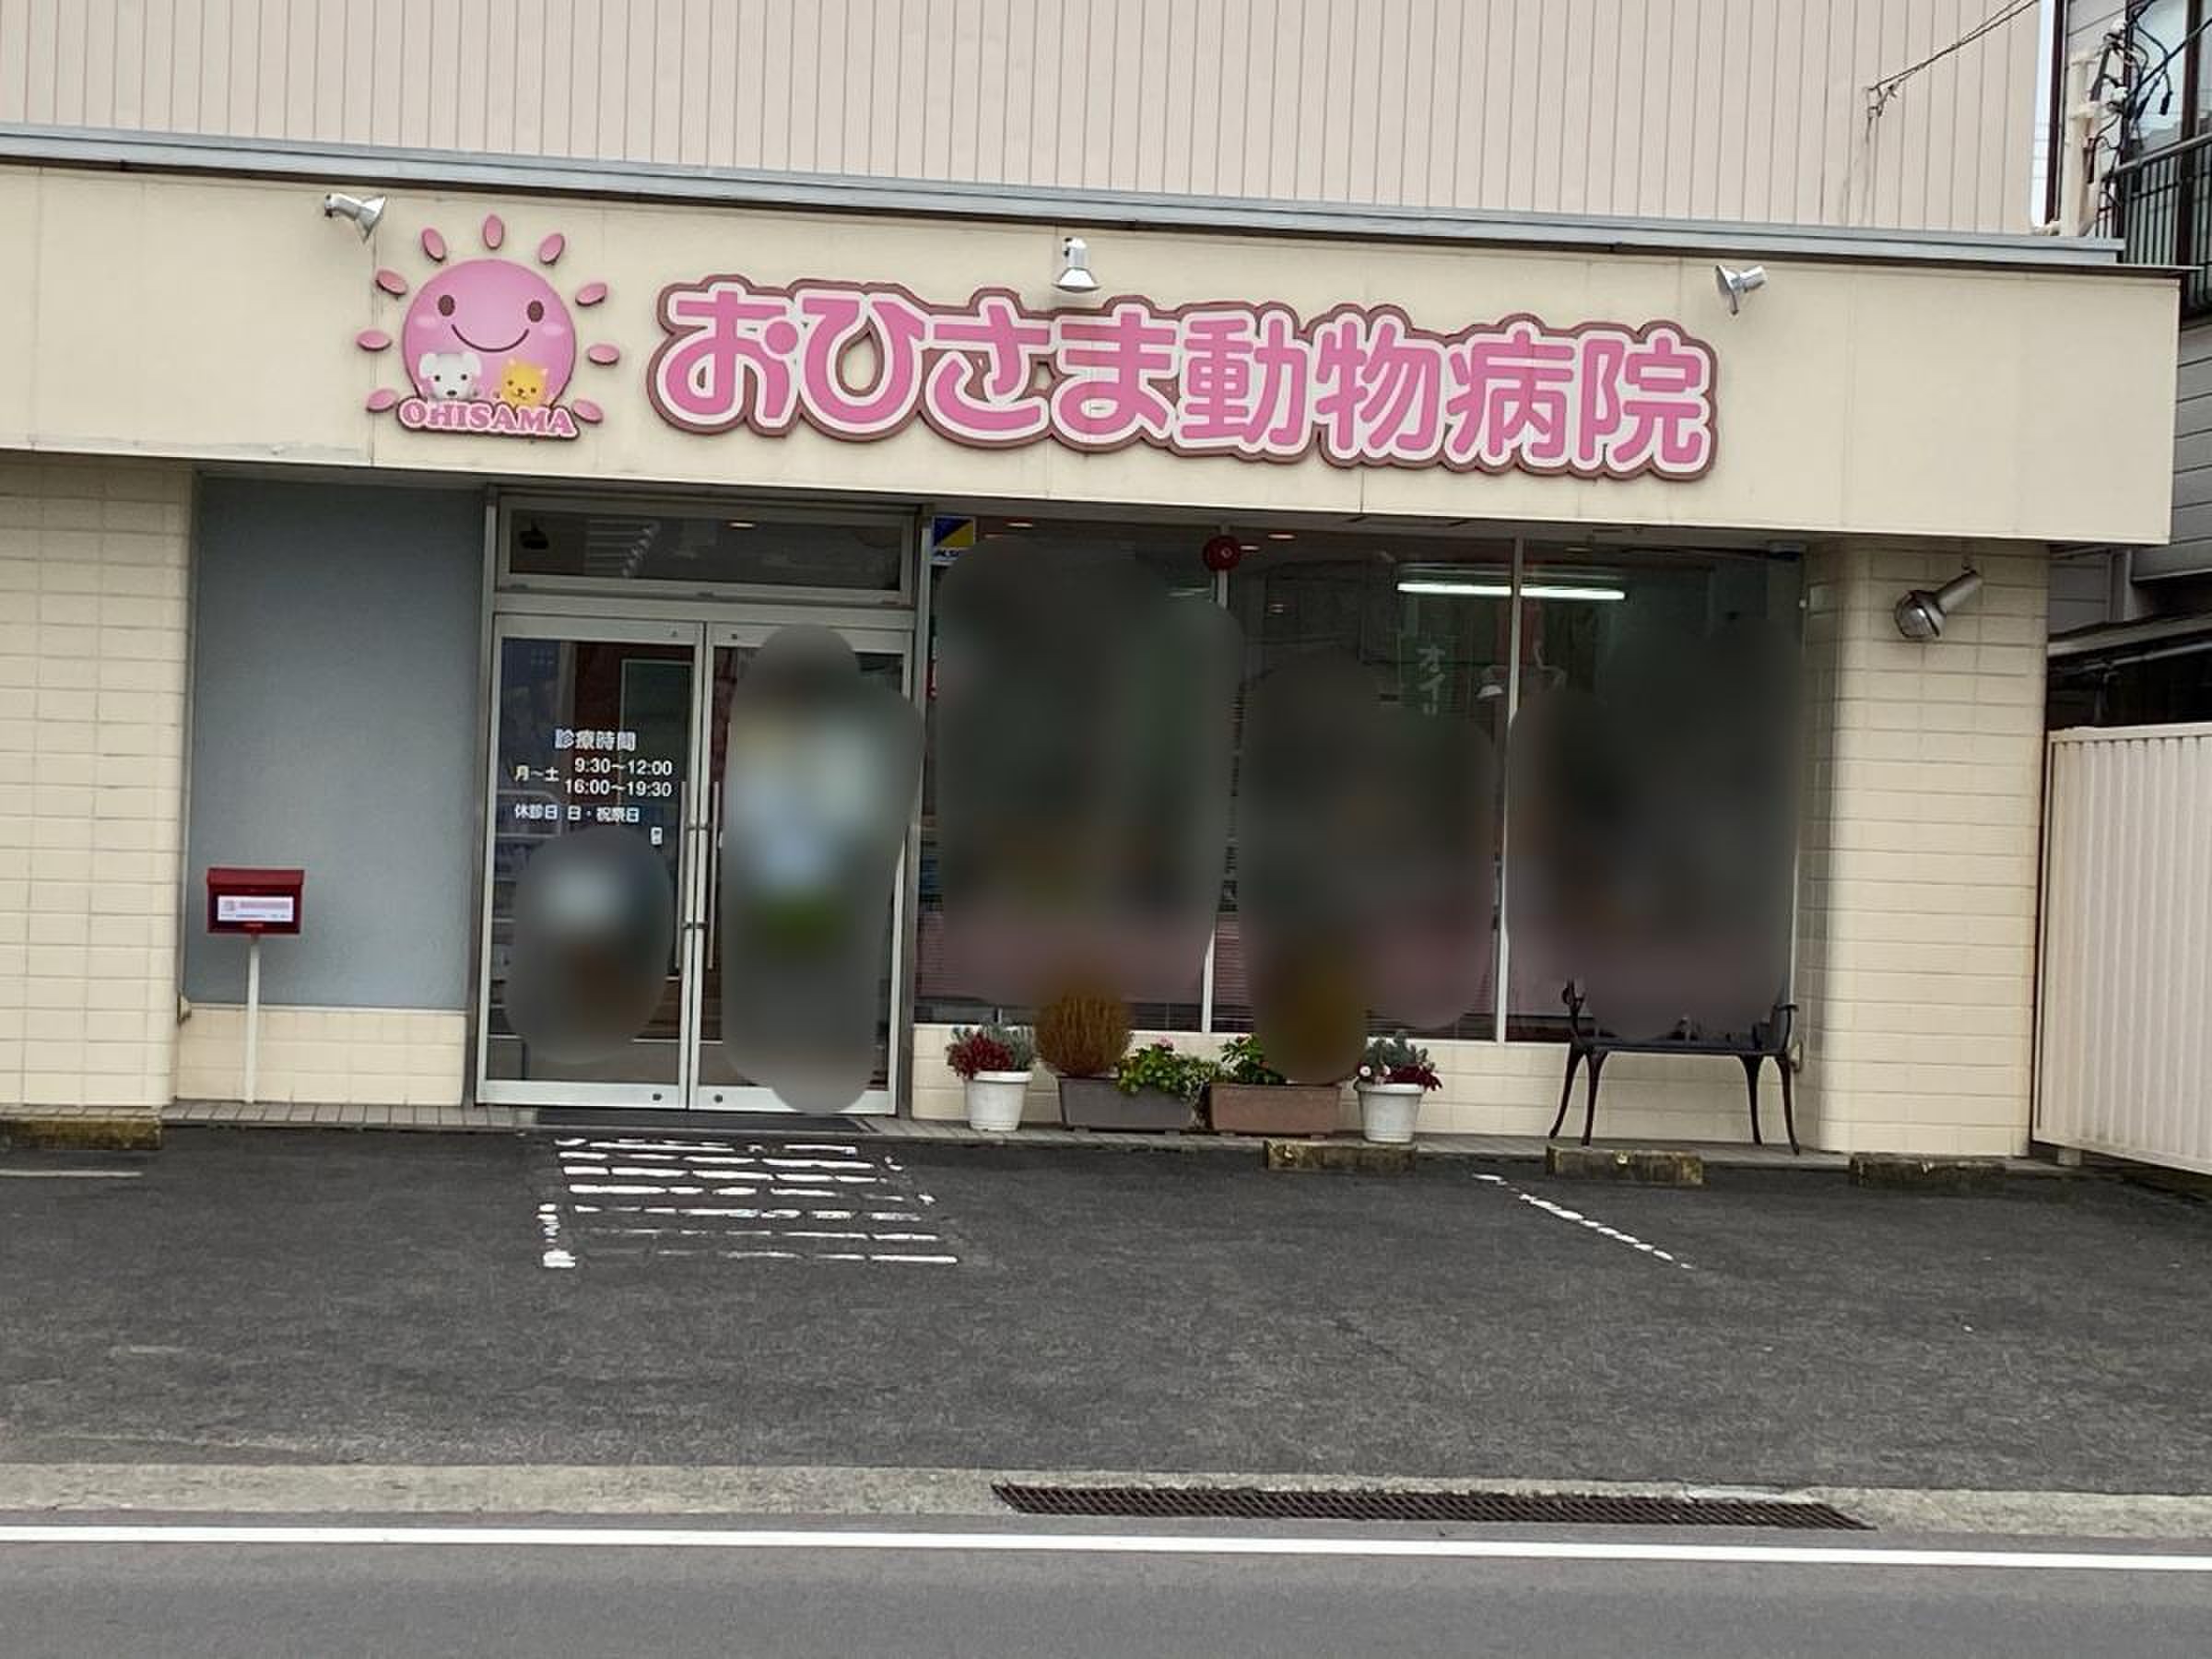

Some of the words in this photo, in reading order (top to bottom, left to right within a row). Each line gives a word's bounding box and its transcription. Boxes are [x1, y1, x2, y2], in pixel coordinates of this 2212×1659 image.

[648, 275, 1717, 481] おひさま動物病院
[398, 397, 580, 439] OHISAMA
[554, 728, 637, 751] 診療時間
[514, 804, 559, 820] 休診日
